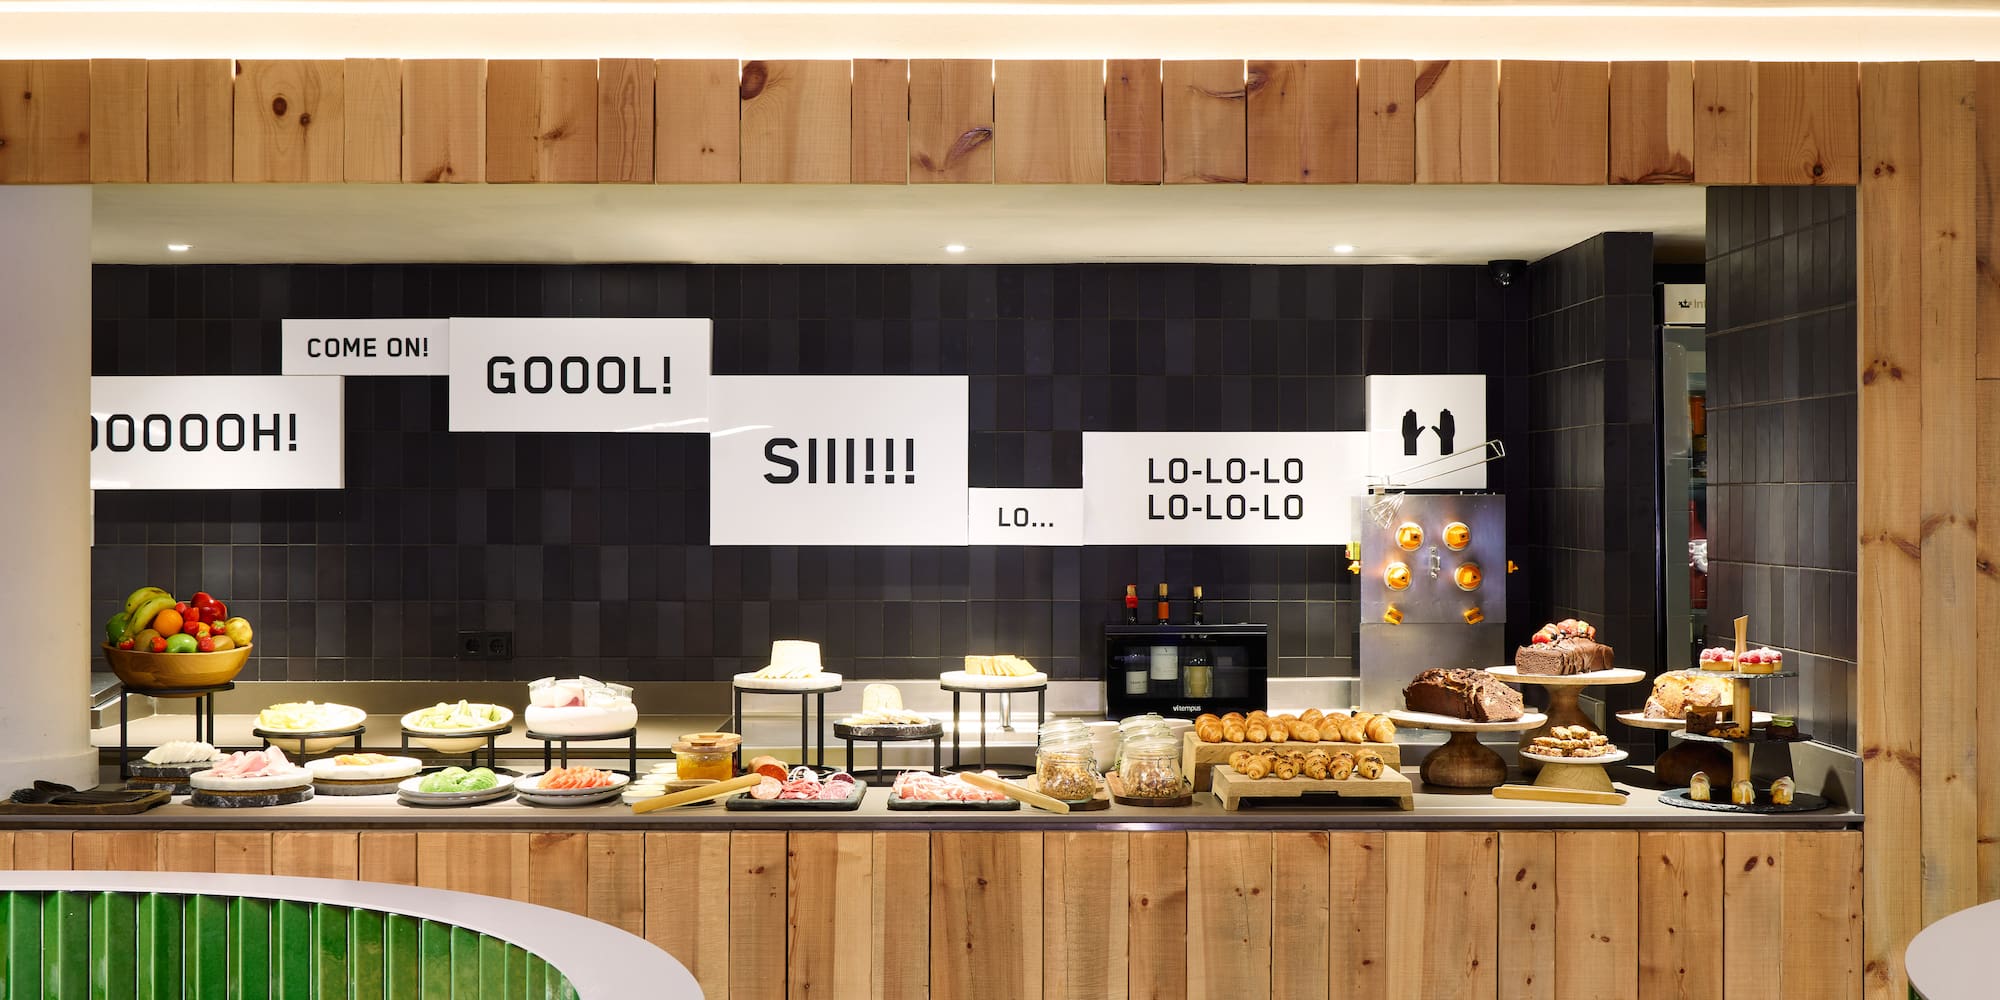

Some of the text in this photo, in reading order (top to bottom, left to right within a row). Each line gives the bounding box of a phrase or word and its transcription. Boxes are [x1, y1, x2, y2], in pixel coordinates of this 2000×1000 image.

[307, 337, 428, 358] COME ON!
[486, 355, 672, 395] GOOOL!
[91, 413, 297, 453] OOOOH!
[763, 437, 915, 485] SIII!!!
[1148, 457, 1304, 484] LO-LO-LO
[998, 507, 1054, 528] LO...
[1148, 494, 1304, 520] LO-LO-LO
